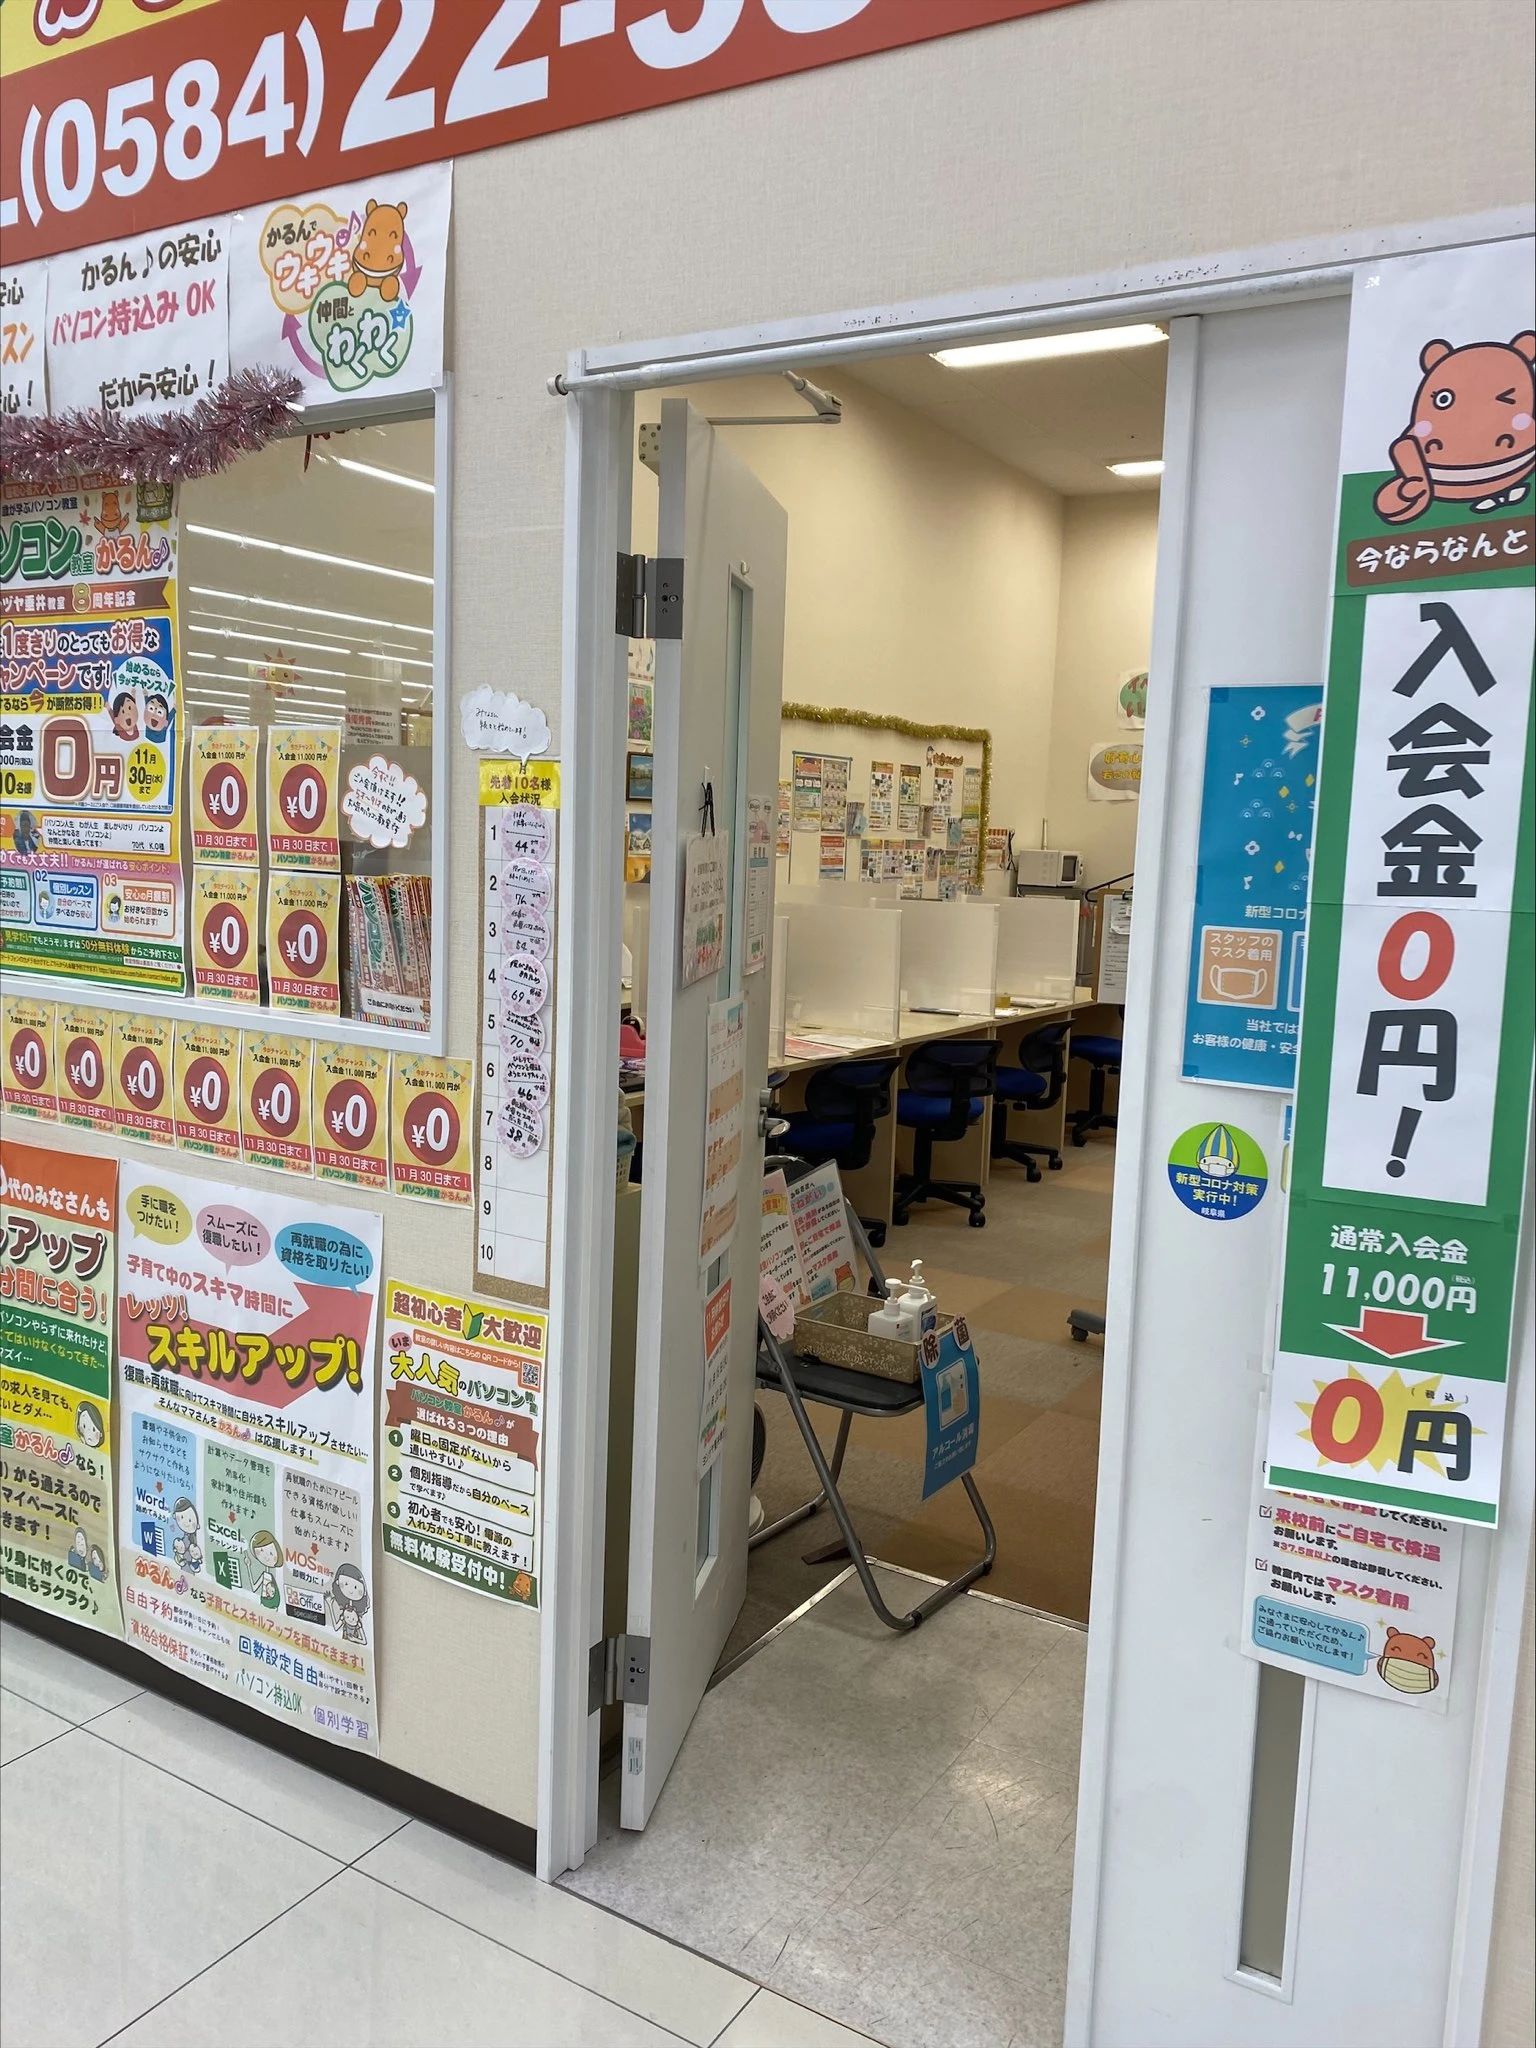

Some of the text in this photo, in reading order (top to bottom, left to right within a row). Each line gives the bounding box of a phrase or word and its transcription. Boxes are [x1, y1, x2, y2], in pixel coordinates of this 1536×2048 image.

[275, 231, 350, 300] ウキウキ
[316, 296, 355, 324] 仲間と
[326, 308, 398, 379] わくわく
[1355, 527, 1530, 573] 今ならなんと
[0, 617, 159, 659] 1度きりのとってもお得な
[0, 689, 103, 714] るなら今が断然お得!!
[134, 748, 157, 765] 11月
[138, 786, 151, 795] まで
[208, 775, 240, 817] ¥0
[286, 777, 319, 820] ¥0
[499, 793, 541, 806] 入会状況
[490, 824, 497, 841] 1
[515, 840, 528, 853] 44
[36, 869, 48, 882] 02
[104, 873, 117, 887] 03
[489, 875, 497, 891] 2
[1355, 600, 1499, 1179] 入会金0円!
[208, 915, 240, 956] ¥0
[285, 923, 319, 965] ¥0
[488, 921, 497, 938] 3
[1210, 932, 1274, 948] スタッフの
[1208, 945, 1273, 962] マスク着用
[488, 968, 496, 984] 4
[511, 989, 525, 1003] 69
[487, 1014, 495, 1030] 5
[510, 1034, 525, 1048] 70
[15, 1040, 40, 1078] ¥0
[70, 1049, 97, 1088] ¥0
[486, 1062, 495, 1078] 6
[126, 1059, 156, 1099] ¥0
[189, 1070, 222, 1111] ¥0
[517, 1086, 533, 1101] 46
[257, 1082, 292, 1124] ¥0
[331, 1093, 368, 1138] ¥0
[485, 1110, 494, 1126] 7
[410, 1106, 450, 1153] ¥0
[506, 1126, 523, 1142] 38
[484, 1155, 492, 1170] 8
[1175, 1171, 1259, 1196] 新型コロナ対策
[1192, 1188, 1238, 1207] 実行中!
[140, 1194, 177, 1216] 手に職を
[483, 1200, 491, 1215] 9
[136, 1211, 179, 1233] つけたい!
[206, 1214, 258, 1237] スムーズに
[202, 1229, 261, 1256] 復職したい!
[290, 1231, 363, 1259] 再就職の為に
[480, 1244, 493, 1260] 10
[1329, 1223, 1470, 1266] 通常入会金
[280, 1246, 370, 1279] 資格を取りたい!
[126, 1253, 294, 1319] 子育て中のスキマ時間に
[1320, 1262, 1478, 1315] 11,000円
[126, 1292, 189, 1322] レッツ!
[393, 1291, 542, 1351] 超初心者 大歓迎
[391, 1335, 410, 1348] いま
[923, 1333, 939, 1367] 除
[146, 1323, 364, 1392] スキルアップ!
[416, 1406, 509, 1447] 選ばれる3つの理由
[1310, 1377, 1473, 1482] 0円
[410, 1428, 512, 1473] 曜日の固定がないから
[0, 1461, 102, 1514] )から通えるので
[410, 1465, 531, 1518] 個別指導だから自分のペース
[1, 1486, 79, 1526] マイペースに
[290, 1507, 354, 1538] 仕事もスムーズに
[1273, 1525, 1339, 1551] お願いします。
[1274, 1506, 1442, 1563] 来校前にご自宅で検温
[389, 1529, 505, 1591] 無料体験受付中!
[1270, 1578, 1337, 1606] お願いします。
[1271, 1563, 1410, 1611] 教室内ではマスク着用
[126, 1585, 173, 1621] 自由予約
[299, 1596, 323, 1612] Office
[1257, 1614, 1344, 1647] に通っていただくため、
[238, 1635, 319, 1687] 回数設定自由
[313, 1705, 369, 1740] 個別学習
